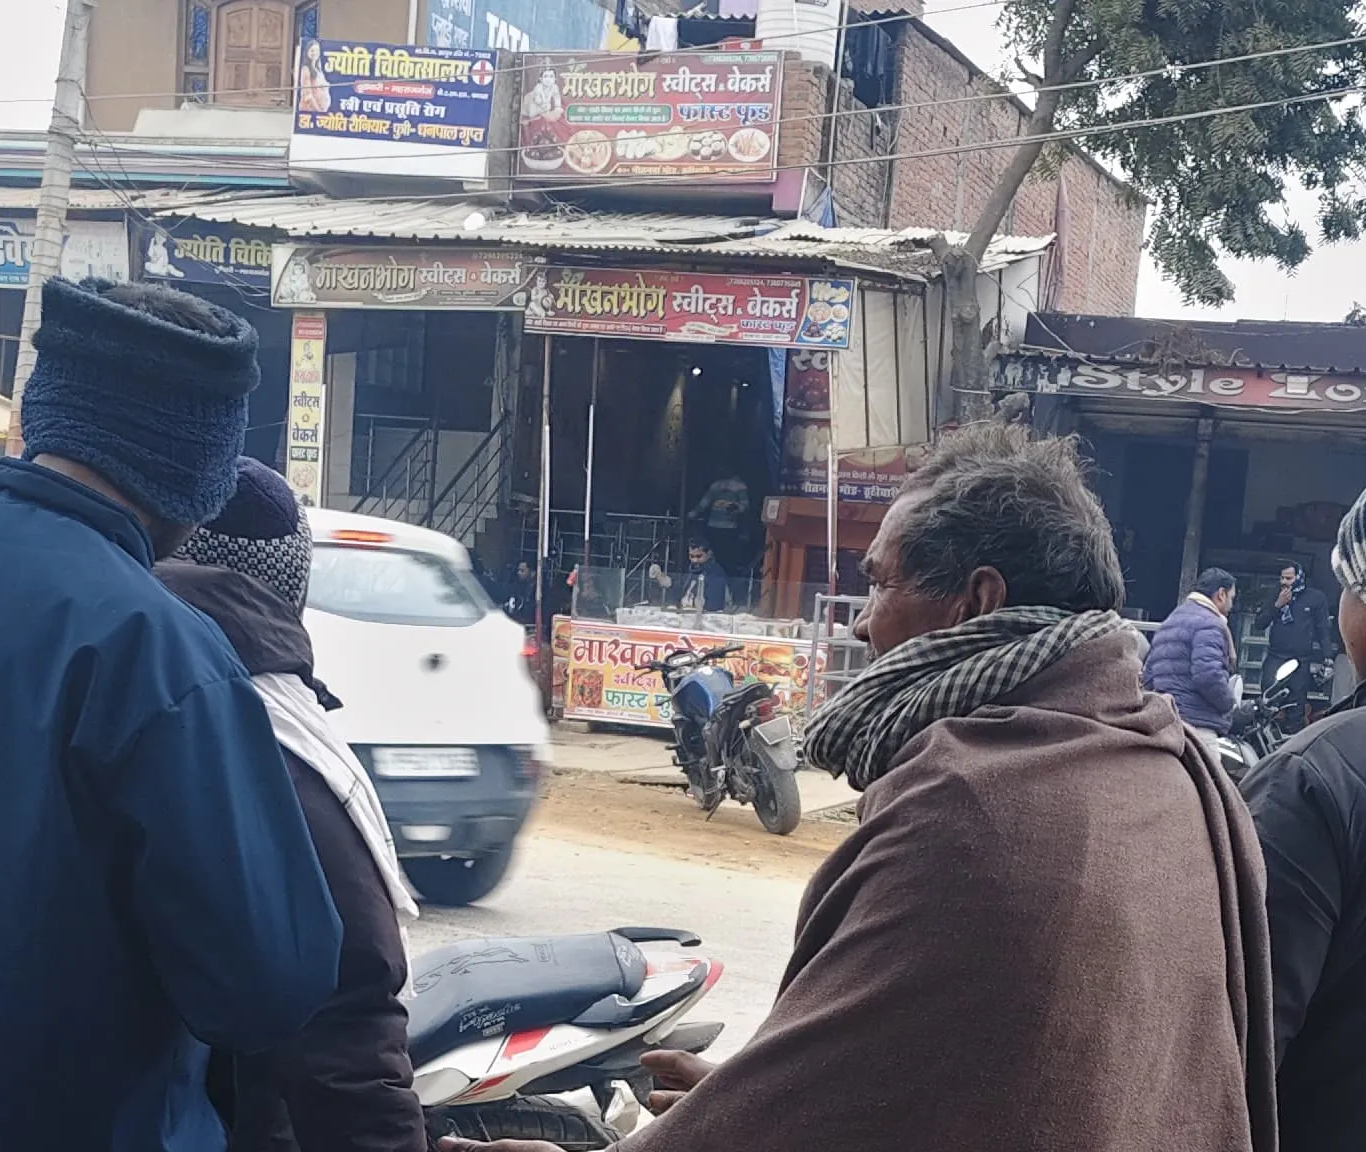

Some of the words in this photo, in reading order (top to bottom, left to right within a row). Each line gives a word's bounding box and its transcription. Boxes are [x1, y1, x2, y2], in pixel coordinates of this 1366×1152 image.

[486, 11, 530, 52] TATA
[324, 46, 373, 76] ज्योति
[375, 48, 472, 83] चिकित्सालय
[672, 285, 735, 323] स्वीट्स
[1071, 363, 1245, 397] Style
[605, 690, 648, 709] फास्ट
